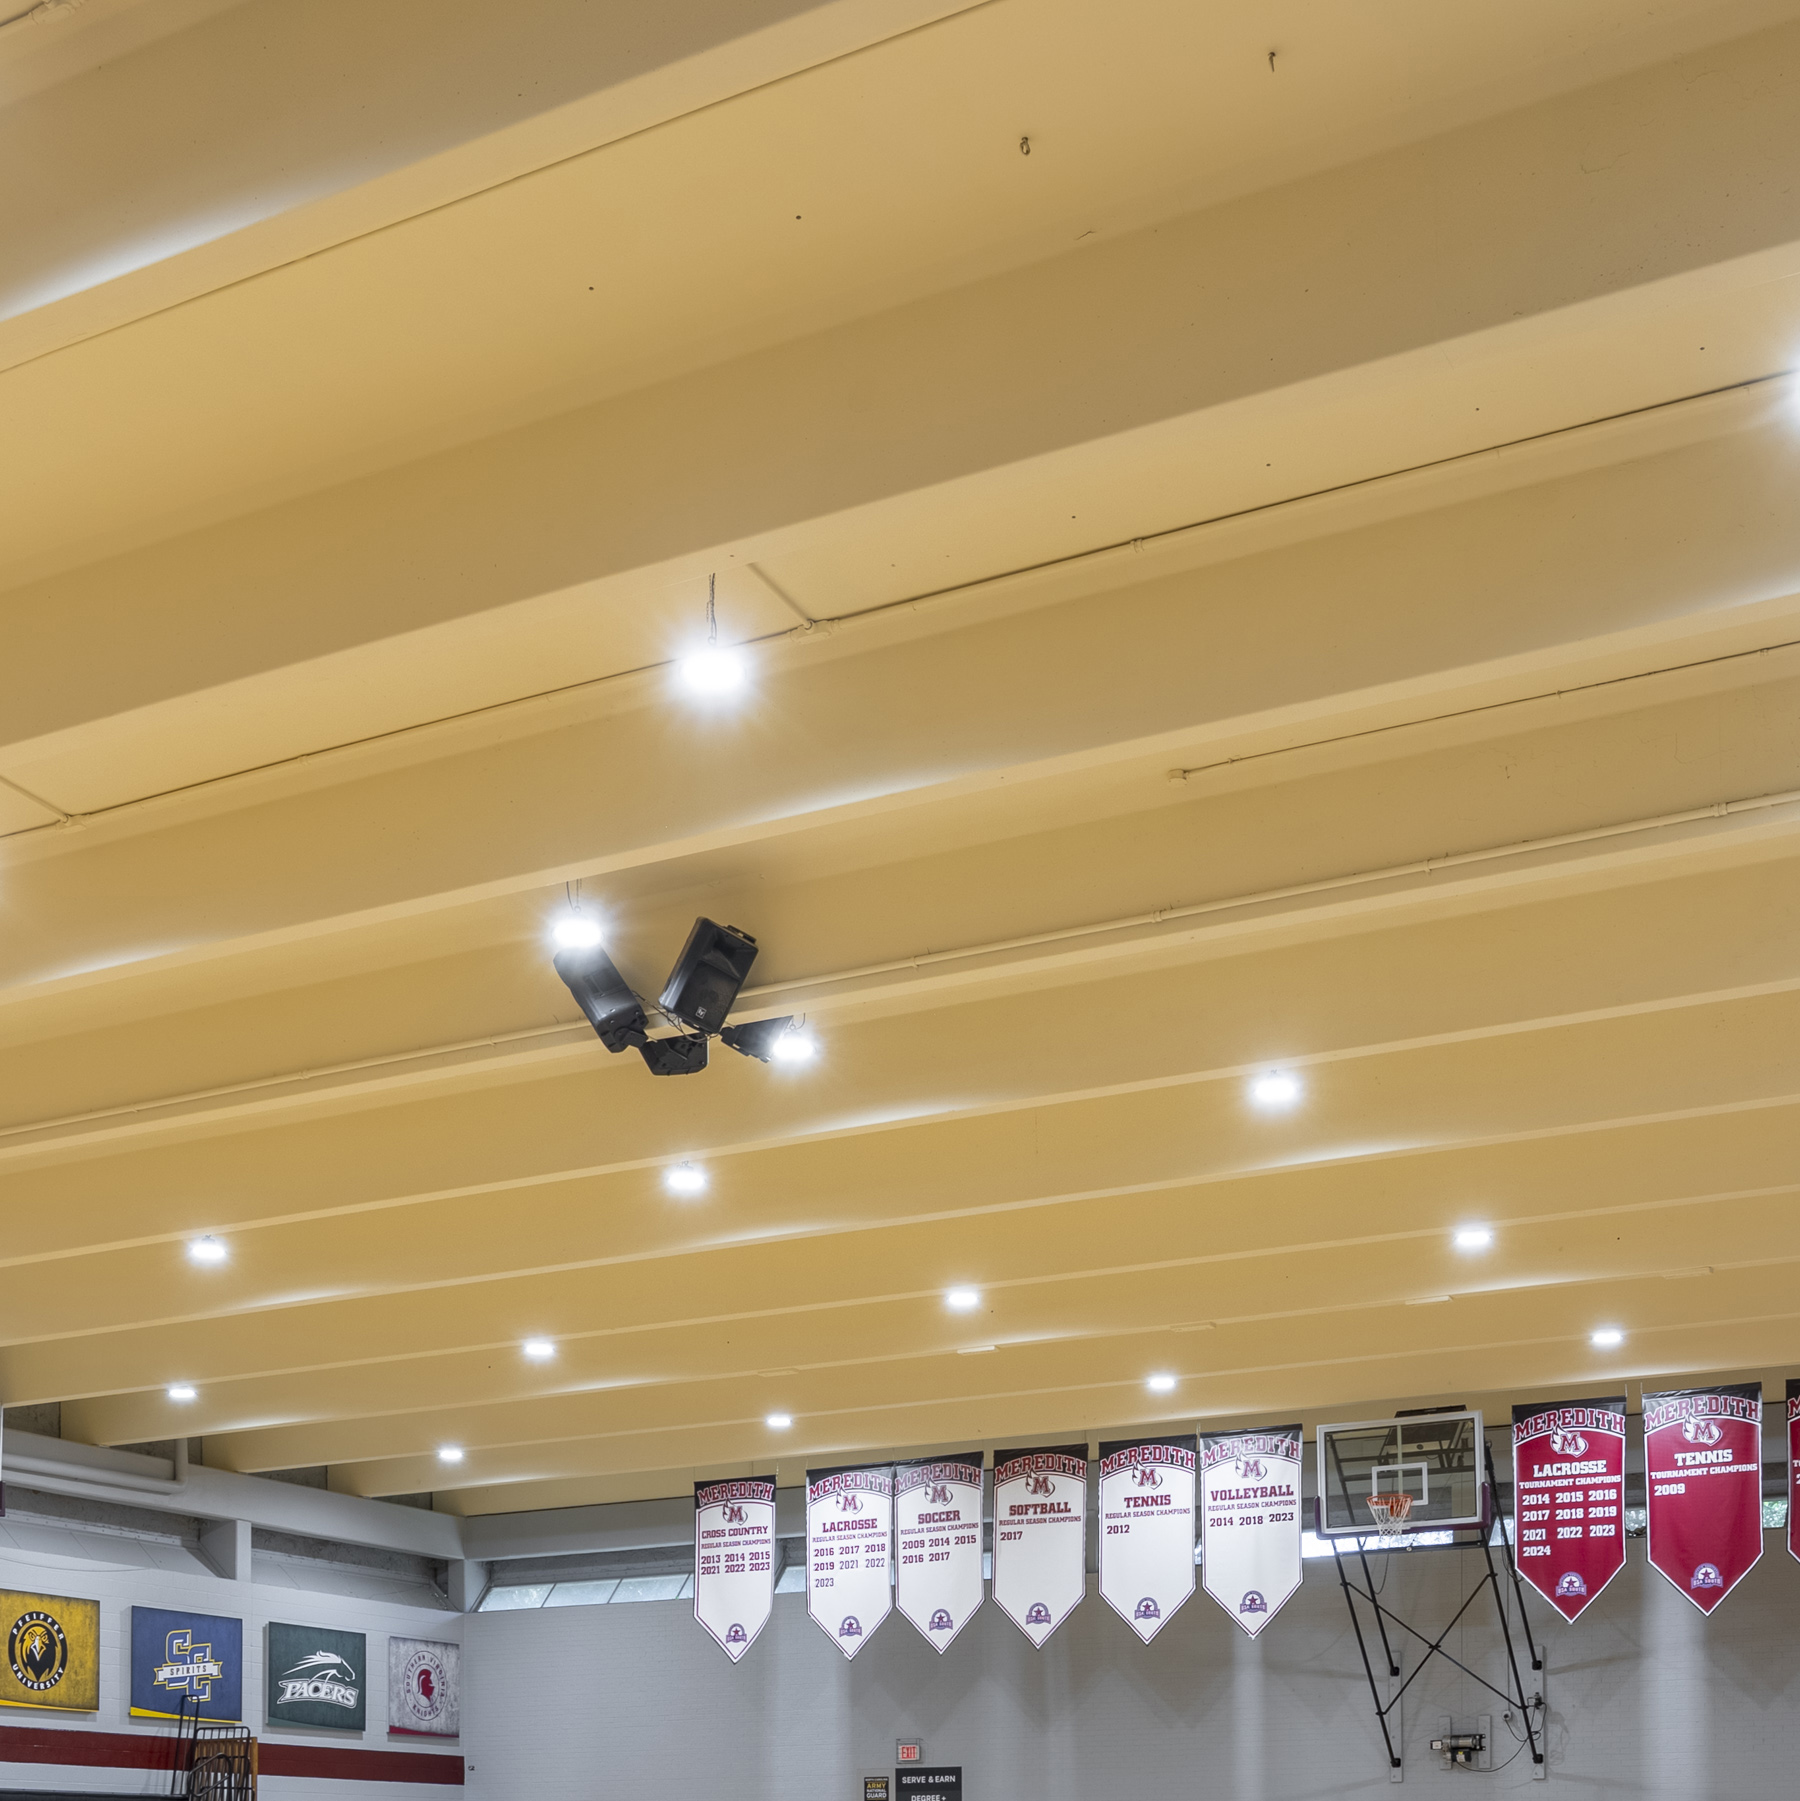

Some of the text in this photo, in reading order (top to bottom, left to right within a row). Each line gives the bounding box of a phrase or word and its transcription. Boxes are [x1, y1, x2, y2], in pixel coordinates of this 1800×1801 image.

[1644, 1395, 1760, 1432] MEREDITH
[1514, 1408, 1626, 1442] MEREDITH
[1202, 1436, 1300, 1468] MEREDITH
[1674, 1448, 1733, 1466] TENNIS
[994, 1453, 1086, 1484] MEREDITH
[1100, 1445, 1196, 1477] MEREDITH
[1533, 1460, 1607, 1478] LACROSSE
[1650, 1464, 1758, 1480] TOURNAMENT CHAMPIONS
[895, 1463, 982, 1494] MEREDITH
[1519, 1475, 1622, 1490] TOURNAMENT CHAMPIONS
[697, 1482, 774, 1506] MEREDITH
[808, 1472, 893, 1501] MEREDITH
[1210, 1484, 1294, 1502] VOLLEYBALL
[1654, 1483, 1686, 1496] 2009
[1124, 1494, 1172, 1508] TENNIS
[1522, 1489, 1617, 1506] 2014 2015 2016
[1009, 1502, 1072, 1516] SOFTBALL
[1208, 1500, 1296, 1512] REGULAR SEASON CHAMPIONS
[918, 1510, 960, 1524] SOCCER
[1133, 1510, 1154, 1518] SEASON
[1210, 1512, 1294, 1527] 2014 2018 2023
[1522, 1506, 1617, 1522] 2017 2018 2019
[702, 1526, 768, 1539] CROSS COUNTRY
[822, 1518, 878, 1533] LACROSSE
[1106, 1524, 1130, 1534] 2012
[1522, 1524, 1616, 1541] 2021 2022 2023
[902, 1535, 976, 1550] 2009 2014 2015
[1000, 1531, 1023, 1540] 2017
[701, 1551, 770, 1564] 2013 2014 2015
[814, 1544, 886, 1557] 2016 2017 2018
[902, 1552, 950, 1564] 2016 2017
[1523, 1545, 1551, 1556] 2024
[701, 1562, 770, 1575] 2021 2022 2023
[814, 1558, 885, 1571] 2019 2021 2022
[816, 1578, 834, 1588] 2023
[12, 1612, 65, 1640] PFEIFFER
[12, 1664, 64, 1690] UNIVERSITY
[170, 1664, 207, 1676] SPIRITS
[282, 1681, 356, 1705] PACERS
[902, 1746, 916, 1759] EXIT
[902, 1776, 926, 1784] SERVE
